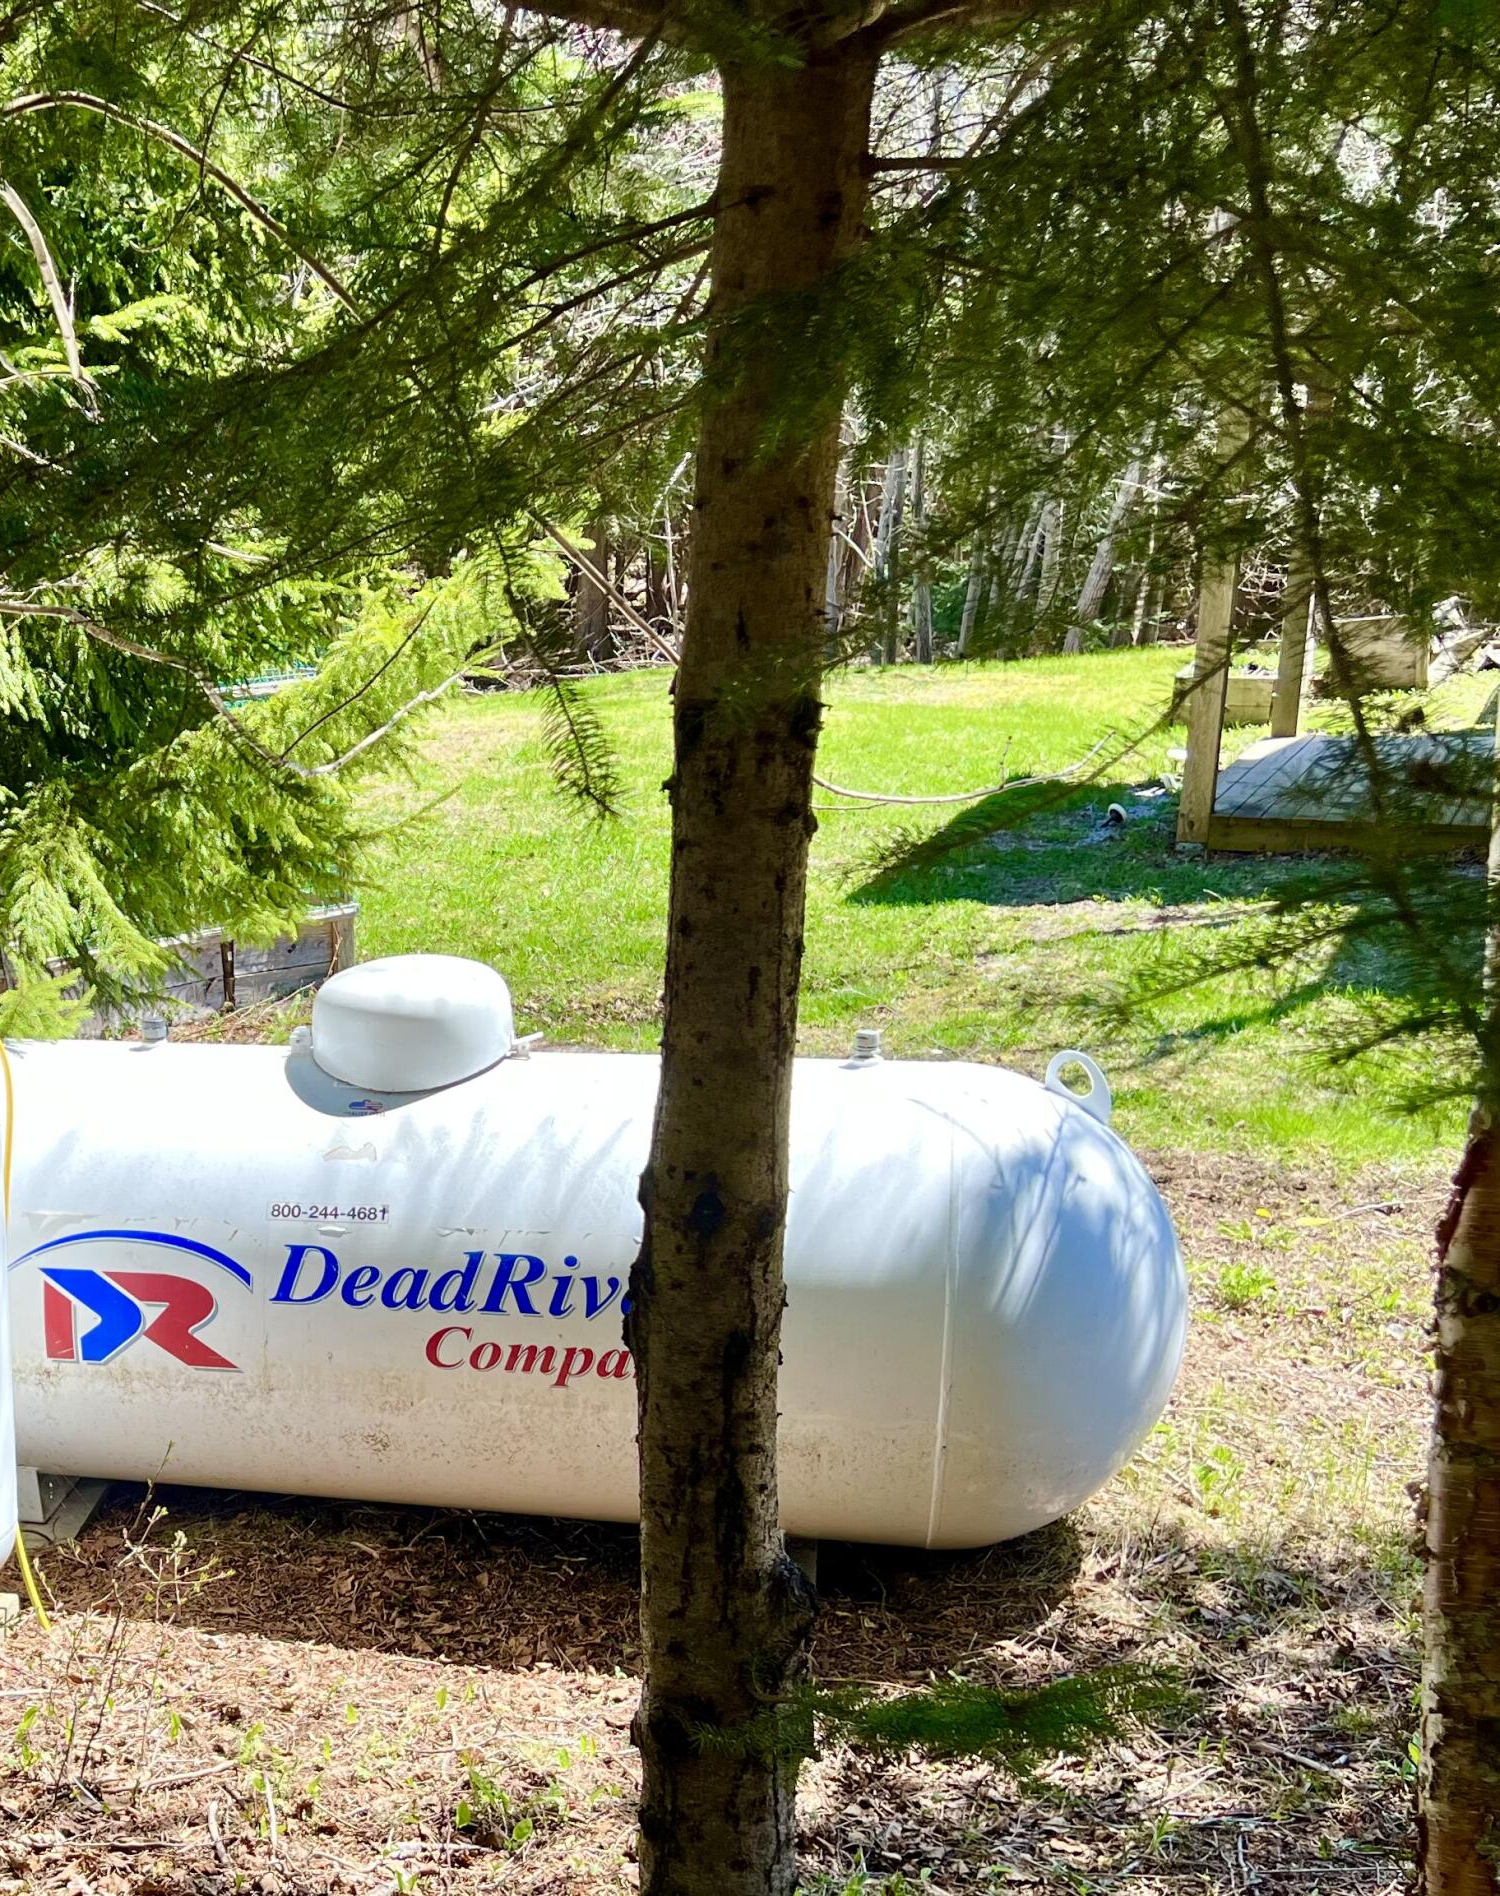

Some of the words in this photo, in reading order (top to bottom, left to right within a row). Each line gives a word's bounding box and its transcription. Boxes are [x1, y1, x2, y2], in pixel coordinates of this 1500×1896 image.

[270, 1203, 387, 1221] 800-244-4681
[269, 1243, 632, 1321] DeadRiv
[425, 1325, 638, 1389] Compa
